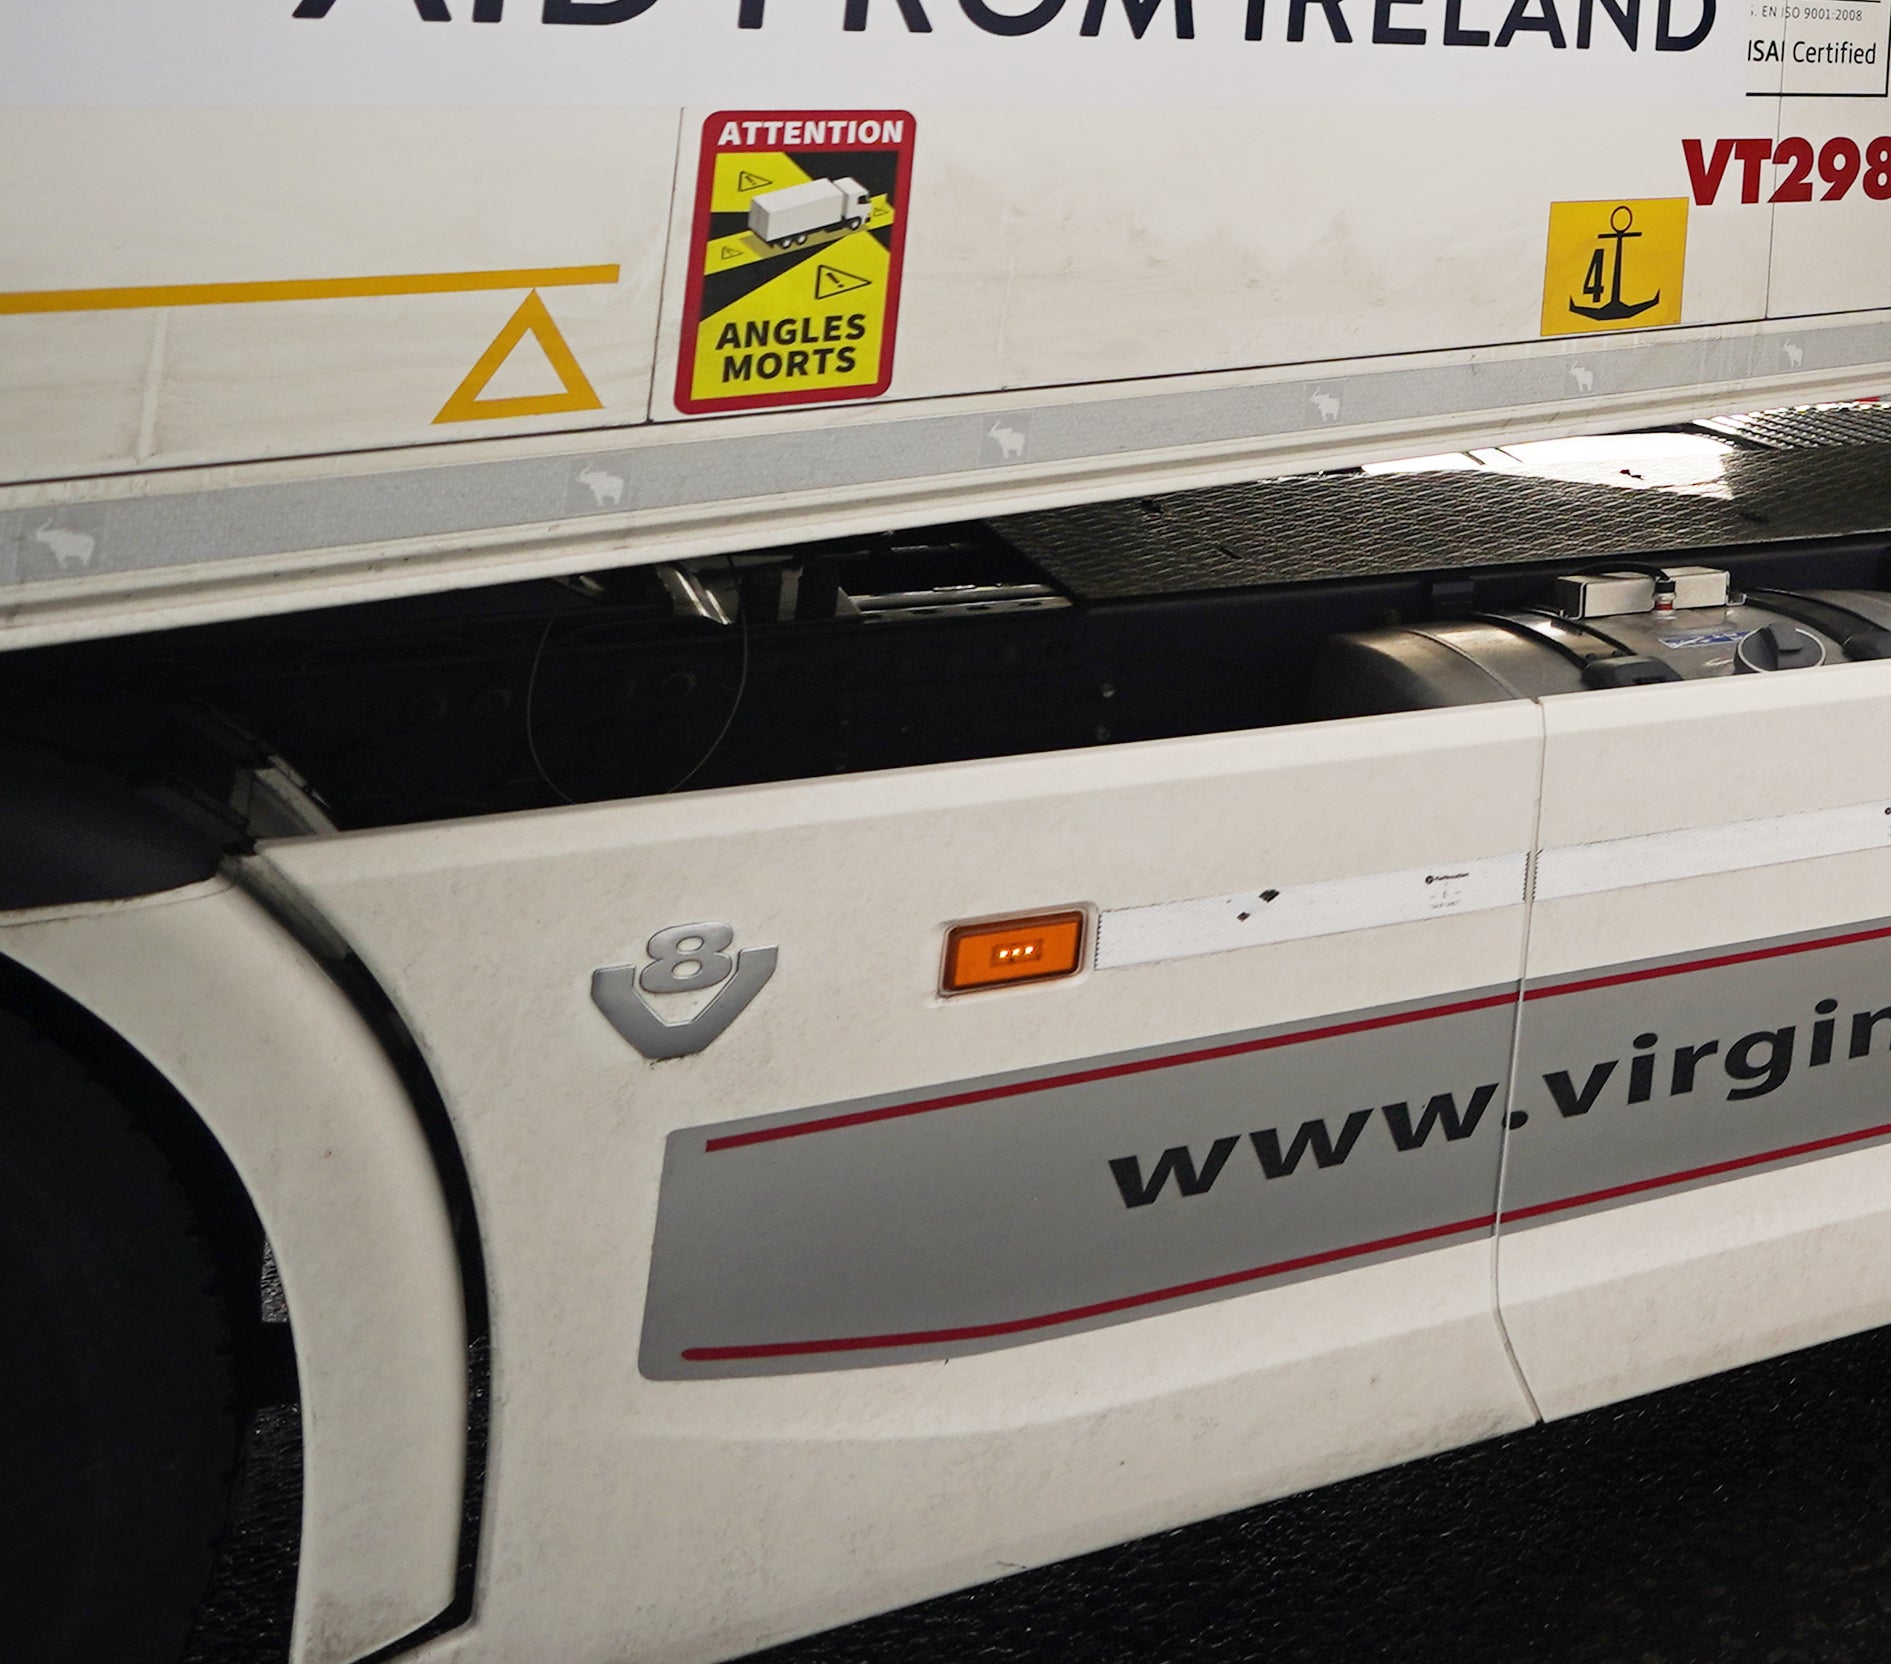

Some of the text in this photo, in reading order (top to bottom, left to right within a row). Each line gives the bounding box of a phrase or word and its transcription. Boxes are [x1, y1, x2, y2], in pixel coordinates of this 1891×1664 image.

[1762, 4, 1777, 18] EN
[1803, 7, 1863, 22] 9001:2008
[1792, 40, 1877, 65] Certified
[717, 119, 905, 146] ATTENTION
[1582, 247, 1605, 303] 4
[715, 312, 867, 352] ANGLES
[721, 345, 857, 385] MORTS
